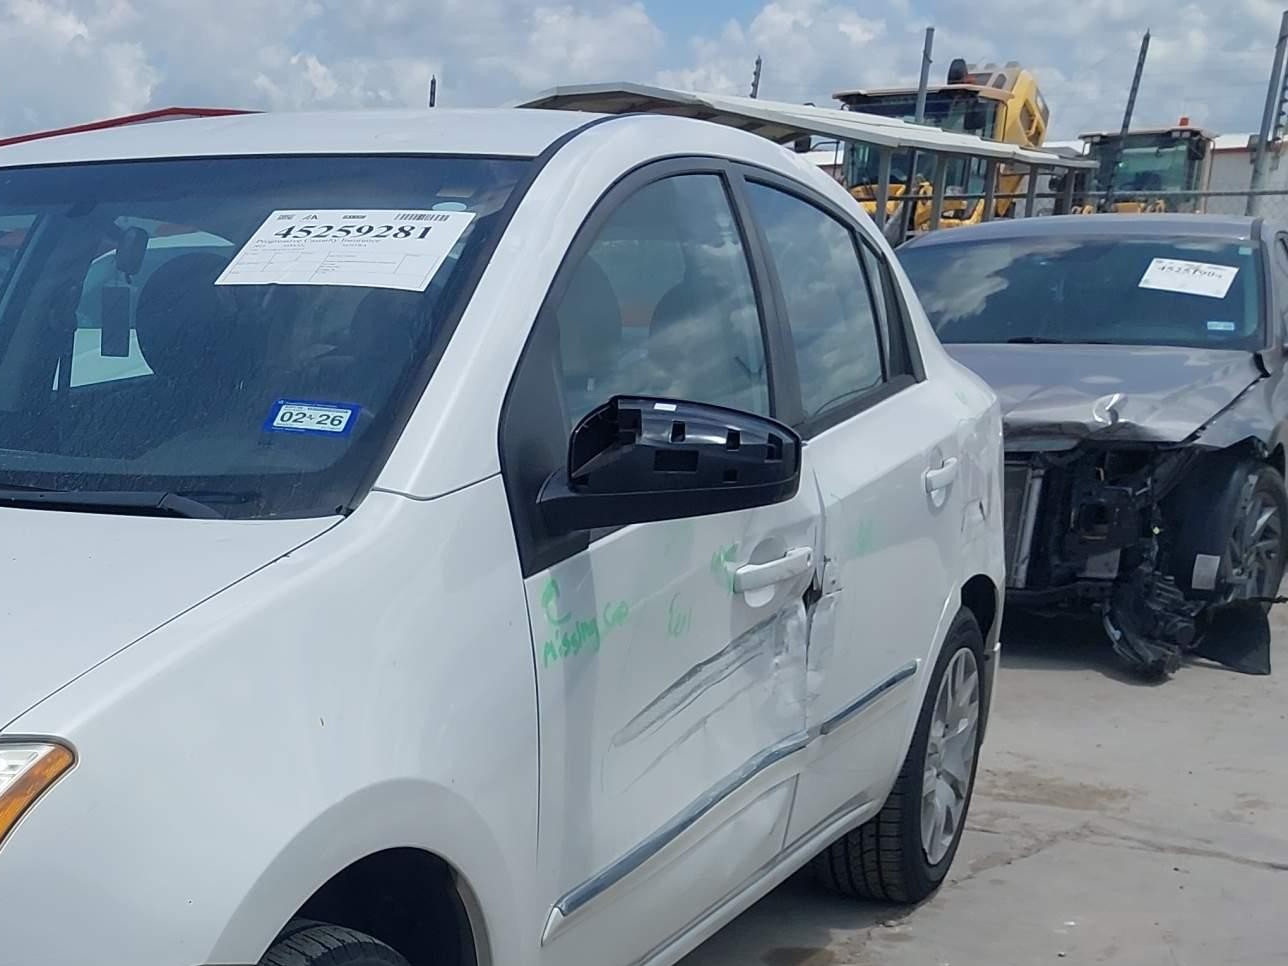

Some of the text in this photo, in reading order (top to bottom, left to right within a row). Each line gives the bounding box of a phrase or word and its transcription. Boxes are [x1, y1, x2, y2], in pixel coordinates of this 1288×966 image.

[274, 224, 433, 240] 45259281
[279, 411, 344, 427] 02 26
